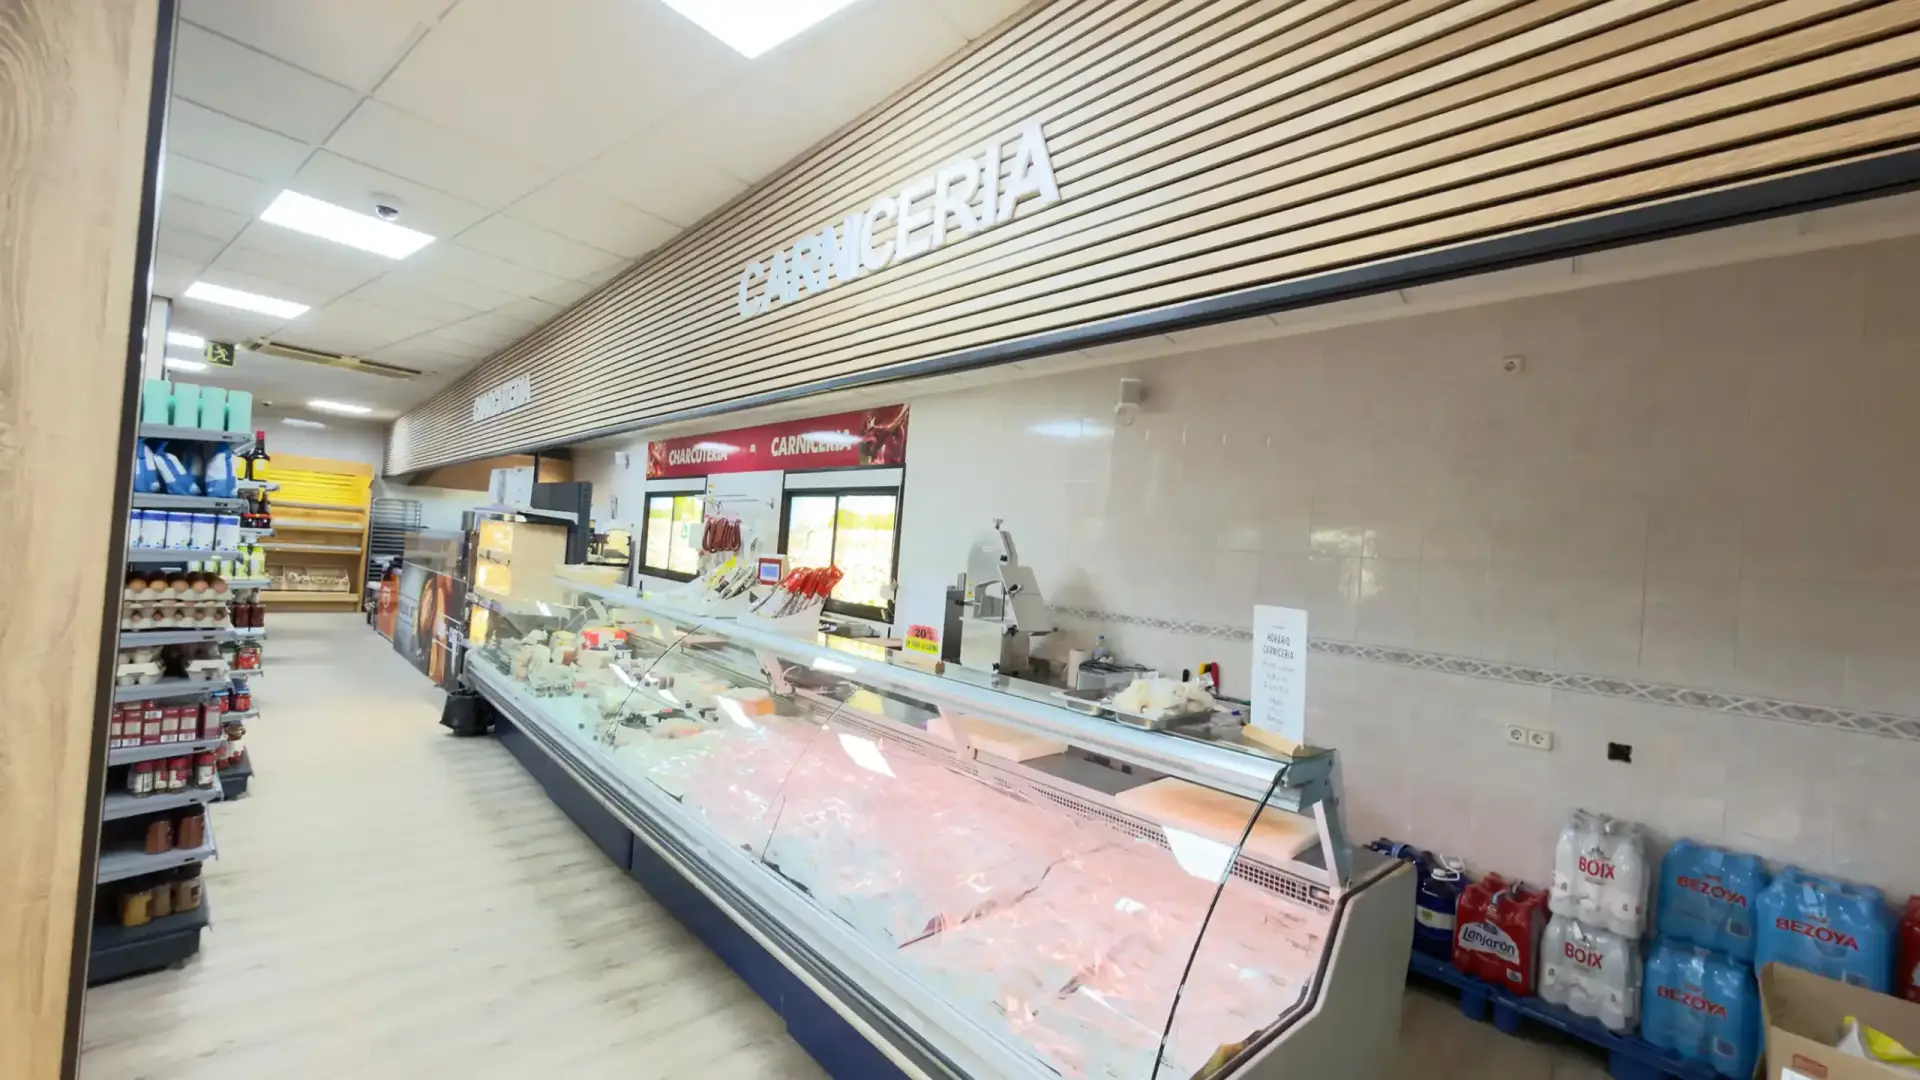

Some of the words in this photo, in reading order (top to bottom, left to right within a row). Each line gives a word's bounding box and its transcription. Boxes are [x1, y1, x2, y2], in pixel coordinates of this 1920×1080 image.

[738, 119, 1061, 318] CARNICERIA
[1578, 855, 1617, 881] BOIX
[1677, 874, 1747, 909] BEZOYA
[1776, 917, 1860, 951] BEZOYA
[1564, 941, 1604, 970] BOIX
[1657, 986, 1727, 1023] BEZOYA
